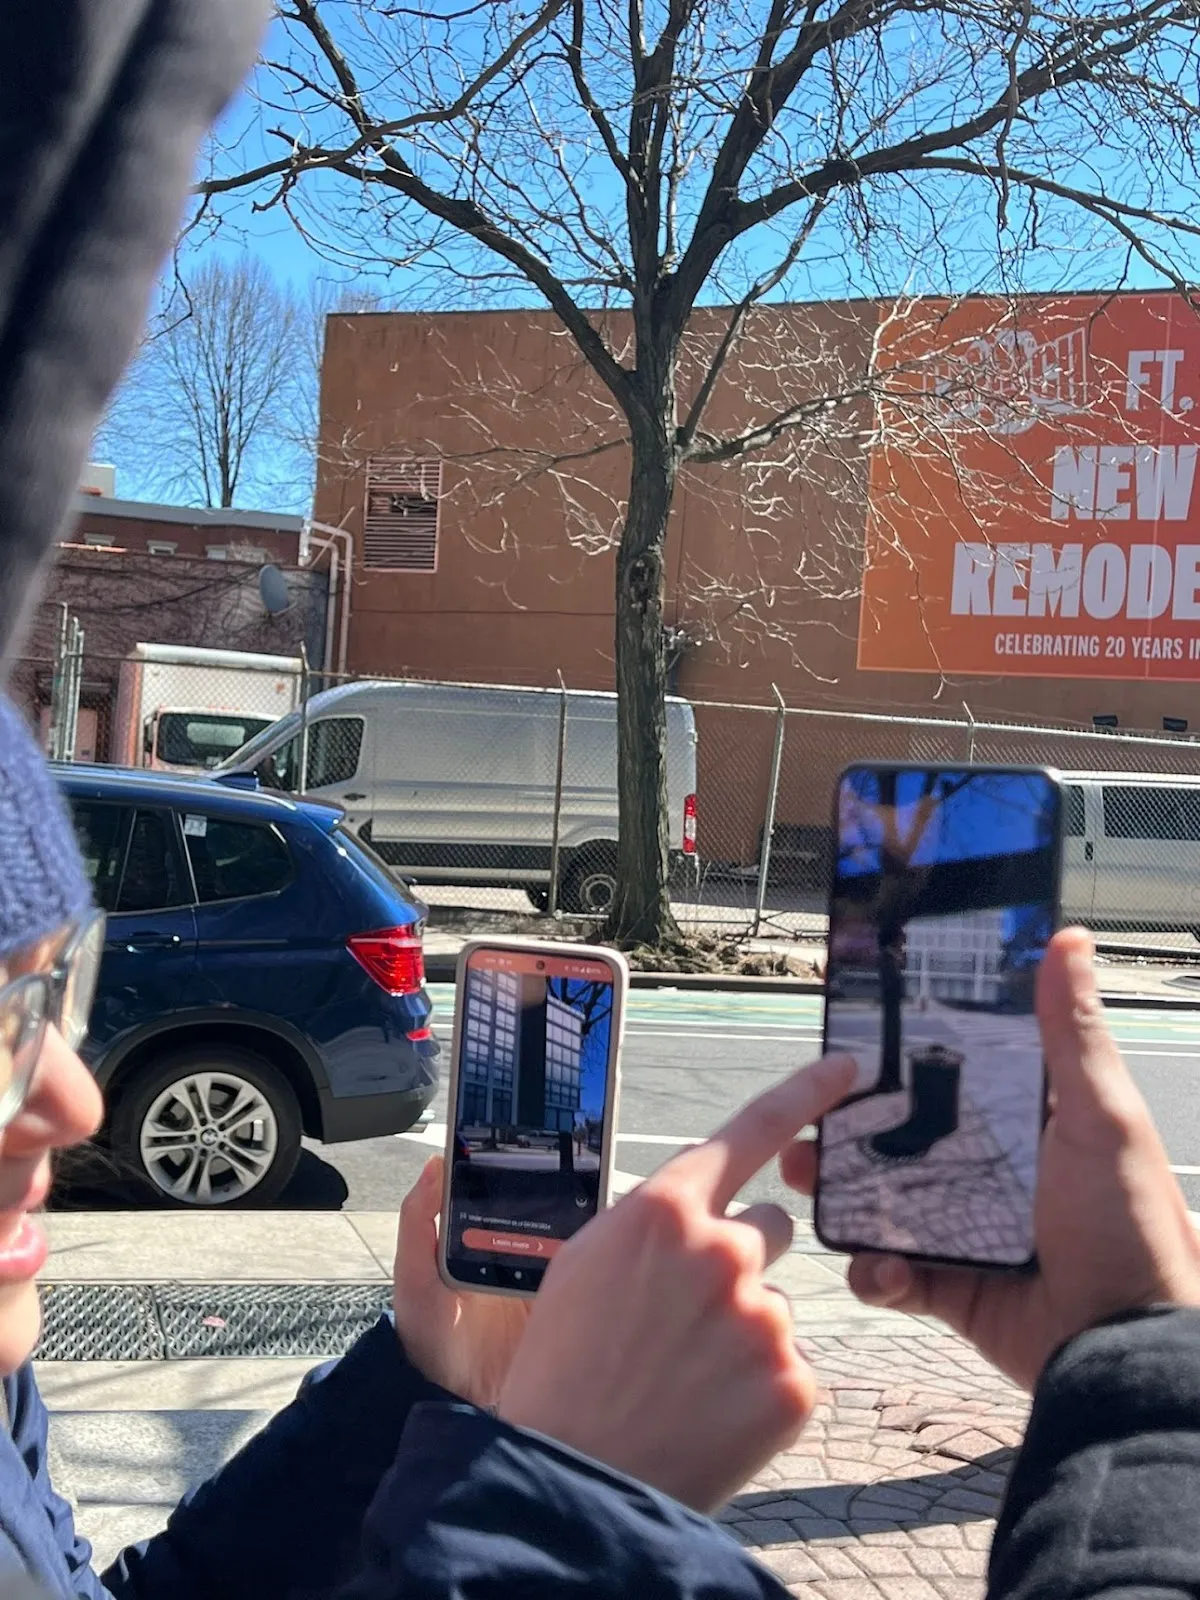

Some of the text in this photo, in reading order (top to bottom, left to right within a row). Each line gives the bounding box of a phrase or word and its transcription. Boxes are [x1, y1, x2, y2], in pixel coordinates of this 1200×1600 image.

[1126, 349, 1194, 411] FT.
[1051, 445, 1198, 520] NEW
[951, 542, 1200, 620] REMODE
[994, 633, 1100, 657] CELEBRATING
[1105, 636, 1126, 658] 20
[1131, 636, 1184, 660] YEARS
